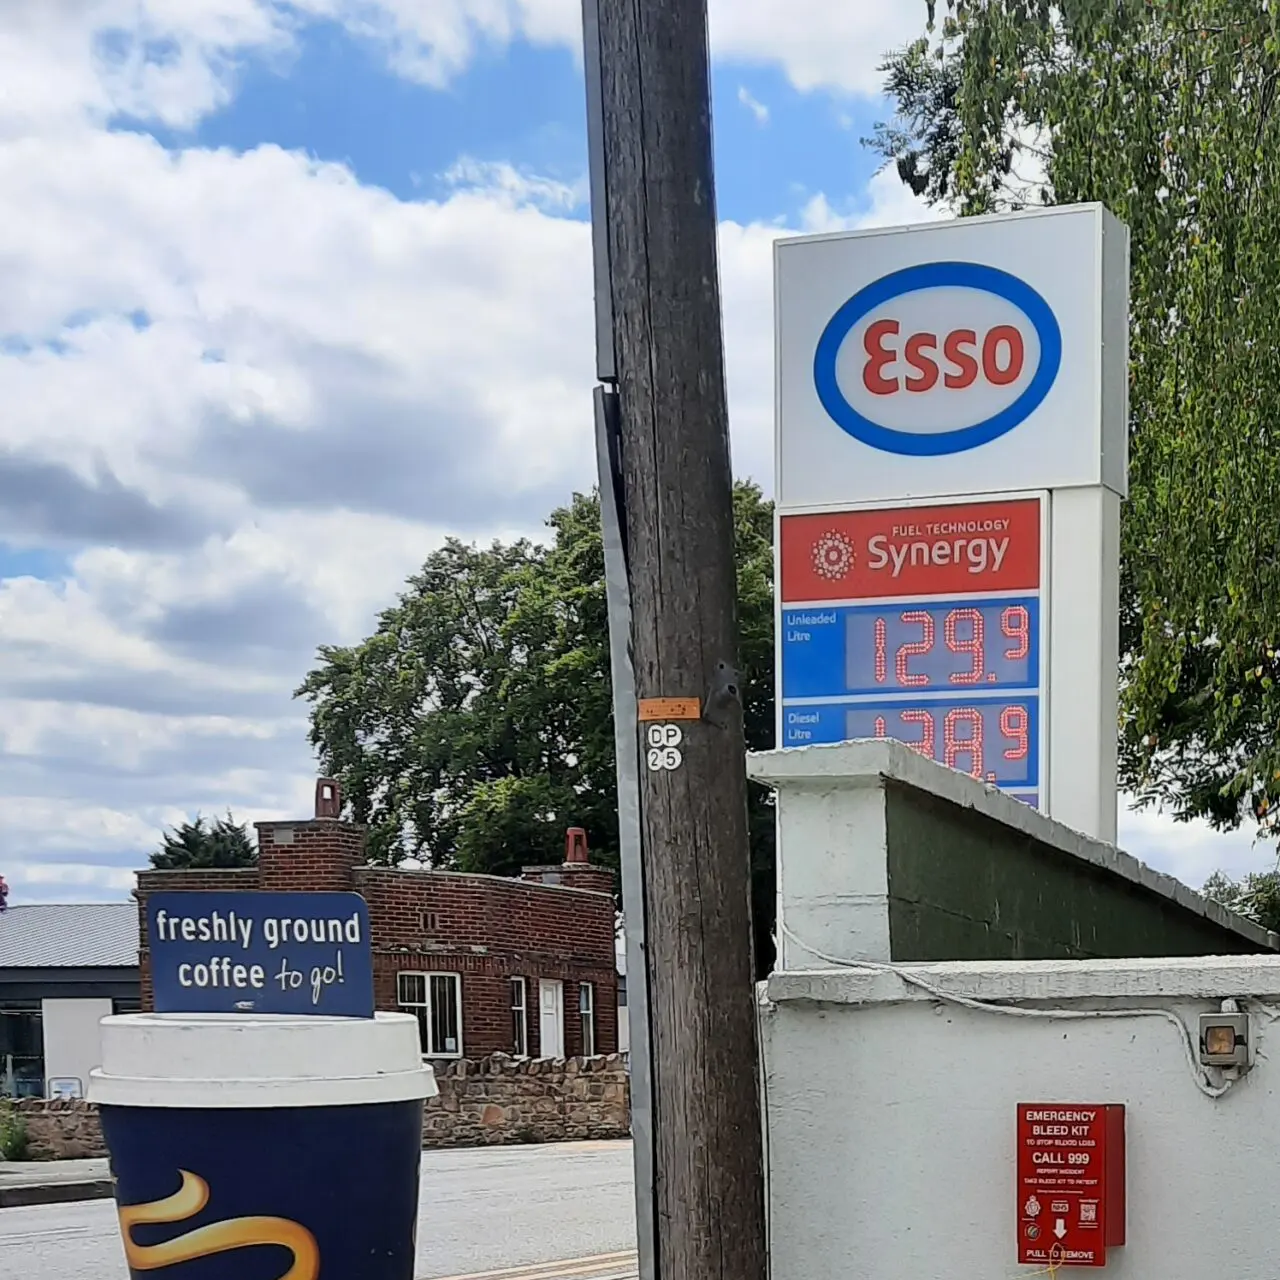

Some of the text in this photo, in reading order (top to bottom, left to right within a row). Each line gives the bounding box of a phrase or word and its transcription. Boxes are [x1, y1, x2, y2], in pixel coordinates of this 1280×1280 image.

[892, 519, 1010, 537] FUEL TECHNOLOGY
[868, 535, 1010, 577] Synergy
[787, 612, 836, 626] Unleaded
[787, 630, 811, 642] Litre
[788, 712, 820, 724] Diesel
[650, 727, 679, 745] DP
[788, 728, 811, 740] Litre
[650, 750, 678, 768] 25
[156, 910, 361, 949] freshly ground
[178, 949, 345, 1005] coffee to go!
[1026, 1111, 1096, 1121] EMERGENCY
[1032, 1125, 1090, 1136] BLEED KIT
[1032, 1152, 1090, 1165] CALL 999
[1026, 1250, 1047, 1258] PULL
